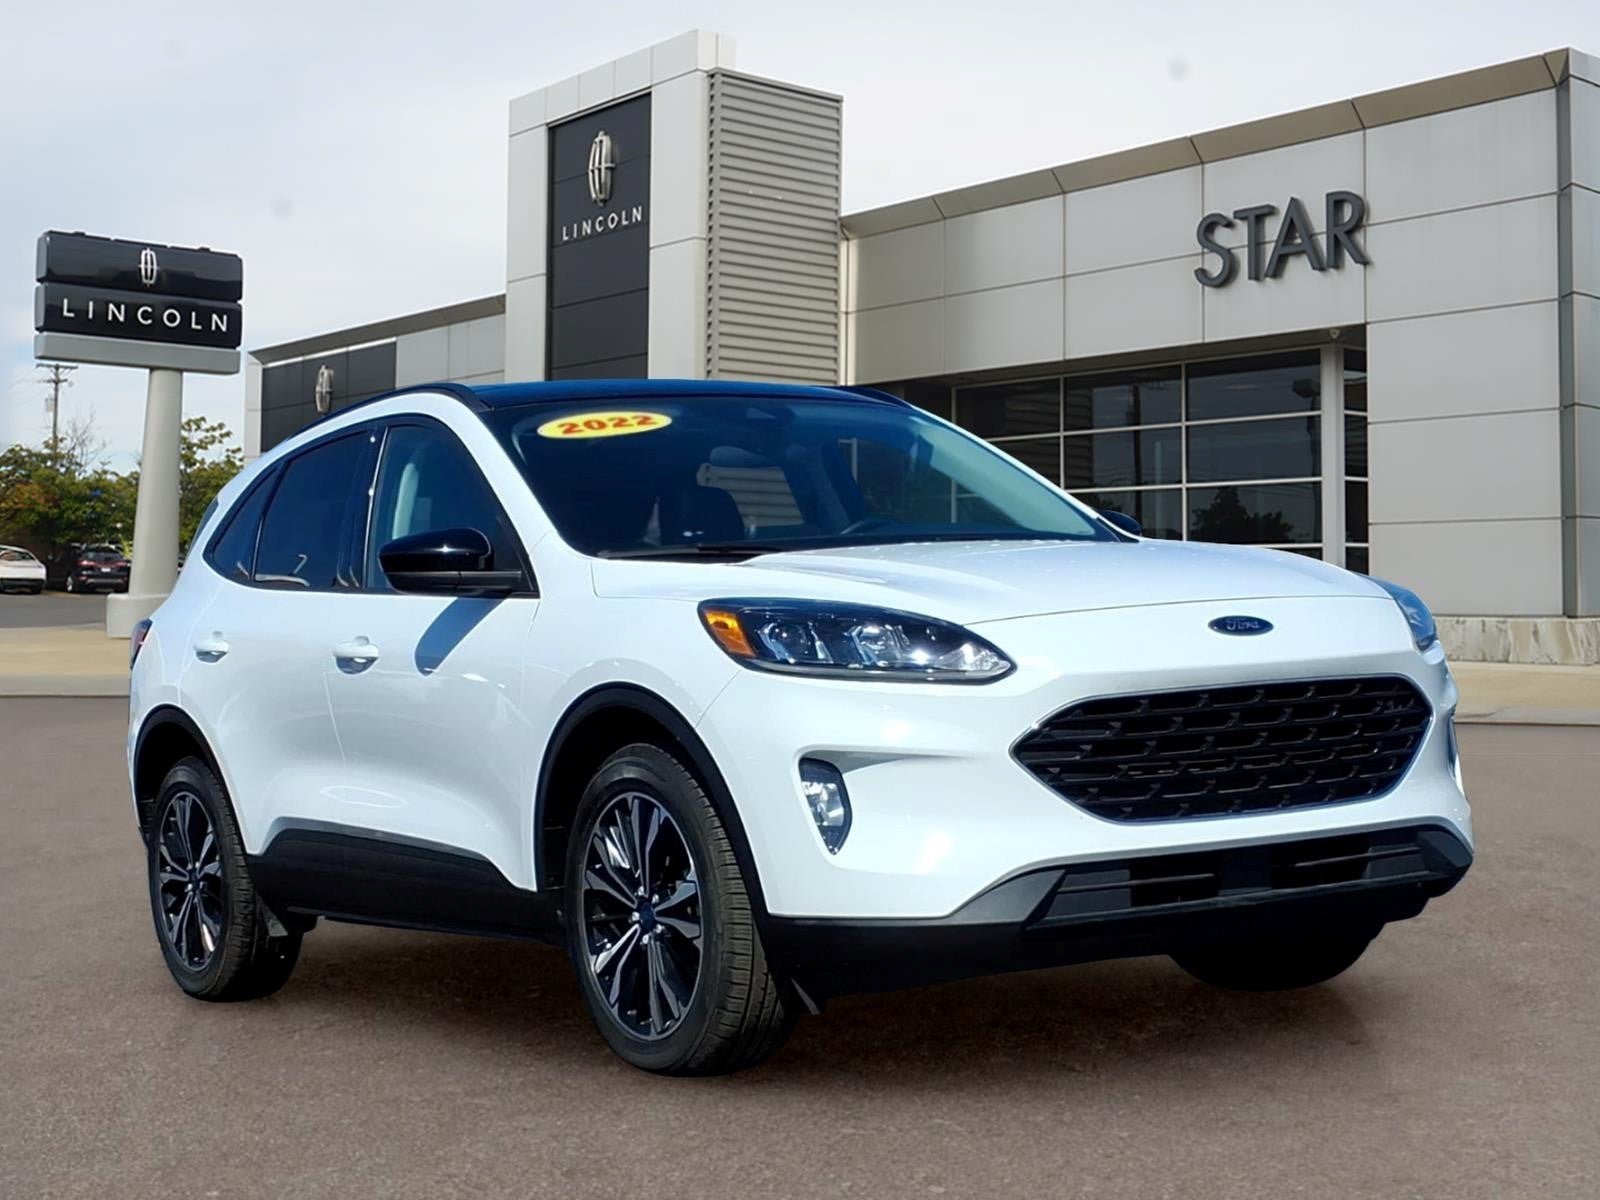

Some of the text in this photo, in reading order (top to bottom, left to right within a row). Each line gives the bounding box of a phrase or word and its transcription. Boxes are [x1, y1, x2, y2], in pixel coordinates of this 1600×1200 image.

[562, 205, 642, 241] LINCOLN
[1194, 190, 1371, 288] STAR
[62, 298, 228, 332] LINCOLN
[557, 415, 658, 435] 2022
